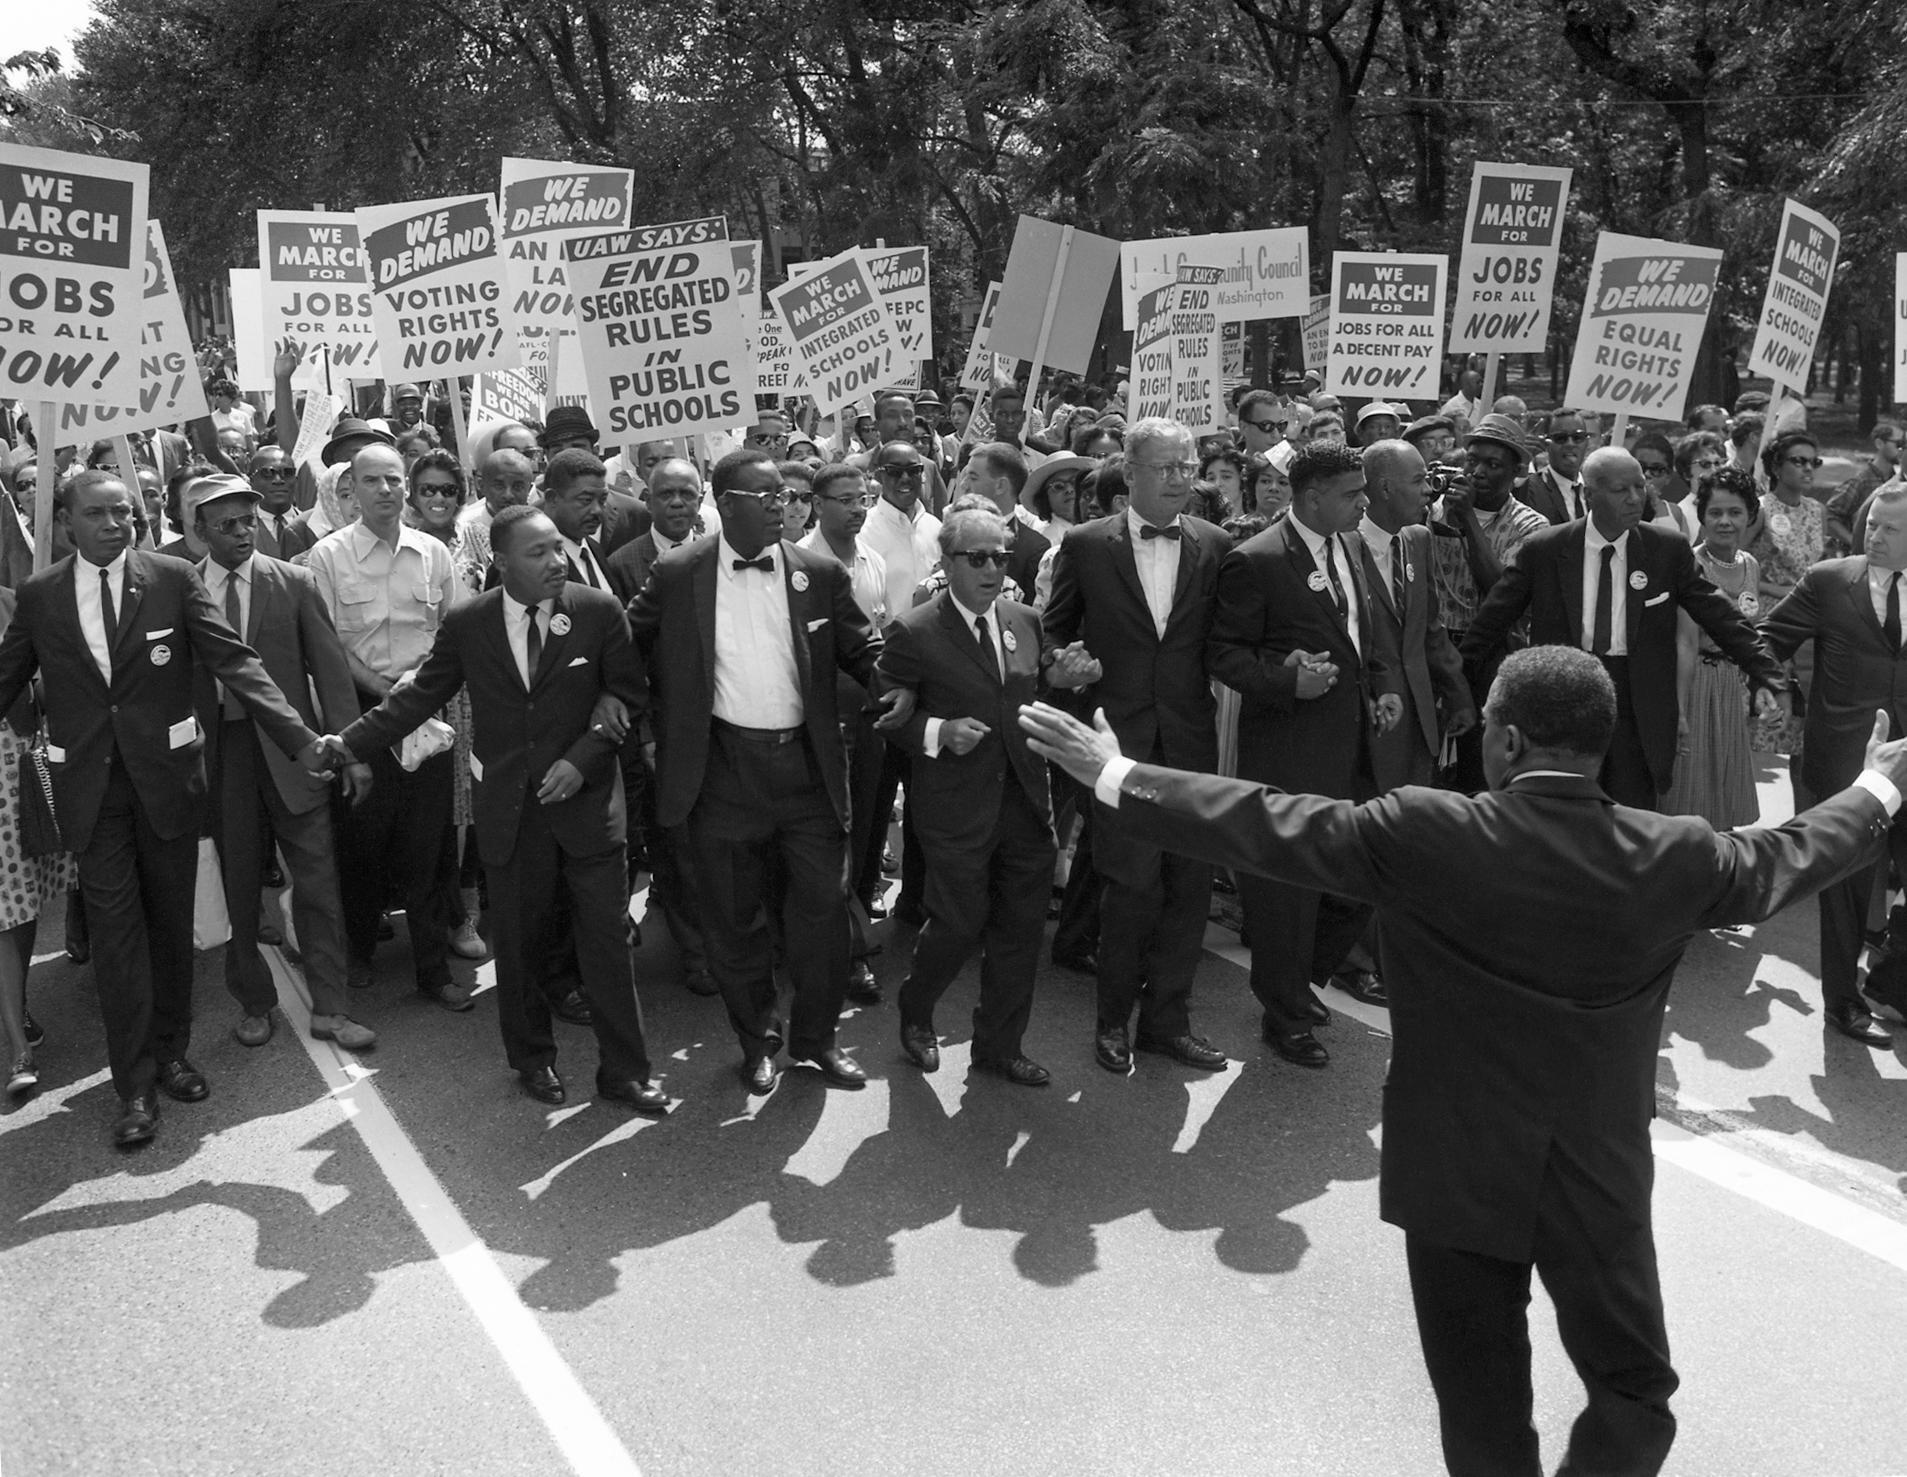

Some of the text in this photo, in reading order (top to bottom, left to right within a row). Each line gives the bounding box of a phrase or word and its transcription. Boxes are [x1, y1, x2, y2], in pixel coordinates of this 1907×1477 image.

[21, 173, 73, 203] WE
[544, 176, 589, 202] WE
[1510, 183, 1534, 201] WE
[511, 197, 621, 232] DEMAND
[1480, 203, 1553, 228] MARCH
[309, 227, 342, 244] WE
[406, 211, 449, 246] WE
[574, 233, 632, 258] UAW
[637, 221, 721, 248] SAYS:
[1501, 230, 1528, 242] FOR
[1808, 227, 1824, 250] WE
[17, 237, 75, 258] FOR
[379, 225, 490, 284] DEMAND
[509, 240, 547, 261] AN
[1785, 239, 1829, 280] MARCH
[599, 252, 700, 289] END
[872, 256, 900, 276] WE
[1258, 242, 1302, 279] Council
[1473, 256, 1543, 284] JOBS
[1638, 259, 1685, 283] WE
[308, 269, 346, 280] FOR
[533, 266, 566, 286] LA
[875, 266, 922, 290] MAND
[1374, 267, 1404, 281] WE
[1798, 269, 1814, 287] FOR
[9, 272, 116, 317] OBS
[385, 280, 500, 312] VOTING
[805, 276, 832, 297] WE
[1346, 282, 1429, 302] MARCH
[1473, 291, 1536, 302] FOR ALL
[1600, 283, 1709, 310] DEMAND
[281, 292, 373, 317] JOBS
[513, 290, 576, 316] NO
[580, 277, 730, 322] SEGREGATED
[792, 279, 862, 328] MARCH
[1155, 286, 1175, 312] WE
[1179, 290, 1209, 310] END
[1371, 303, 1404, 313] FOR
[1772, 280, 1821, 321] INTEGRATED
[0, 316, 109, 341] OR ALL
[285, 322, 373, 333] FOR ALL
[398, 307, 500, 338] RIGHTS
[605, 309, 713, 347] RULES
[764, 323, 782, 333] One
[818, 308, 847, 326] FOR
[1172, 313, 1215, 335] SEGREGATED
[1464, 309, 1540, 339] NOW!
[1766, 307, 1814, 347] SCHOOLS
[800, 308, 880, 360] INTEGRATED
[1335, 322, 1434, 337] JOBS FOR ALL
[1603, 320, 1682, 352] EQUAL
[403, 327, 503, 369] NOW!
[529, 350, 550, 361] FO
[644, 349, 682, 366] IN
[757, 346, 787, 363] PEAK
[809, 329, 890, 379] SCHOOLS
[976, 353, 988, 361] FO
[1178, 337, 1209, 359] RULES
[1333, 342, 1344, 355] A
[1347, 343, 1400, 356] DECENT
[1404, 345, 1433, 358] PAY
[1762, 339, 1806, 376] NOW!
[0, 345, 120, 390] OW!
[774, 363, 790, 371] FO
[1138, 352, 1171, 372] VOTIN
[1187, 366, 1199, 378] IN
[1595, 345, 1682, 378] RIGHTS
[609, 360, 730, 401] PUBLIC
[826, 347, 892, 402] NOW!
[970, 366, 991, 382] NO
[1341, 365, 1427, 388] NOW!
[496, 382, 512, 398] WE
[1139, 376, 1171, 397] RIGHT
[1177, 379, 1210, 403] PUBLIC
[1586, 374, 1678, 408] NOW!
[609, 390, 741, 432] SCHOOLS
[1176, 404, 1212, 427] SCHOOLS
